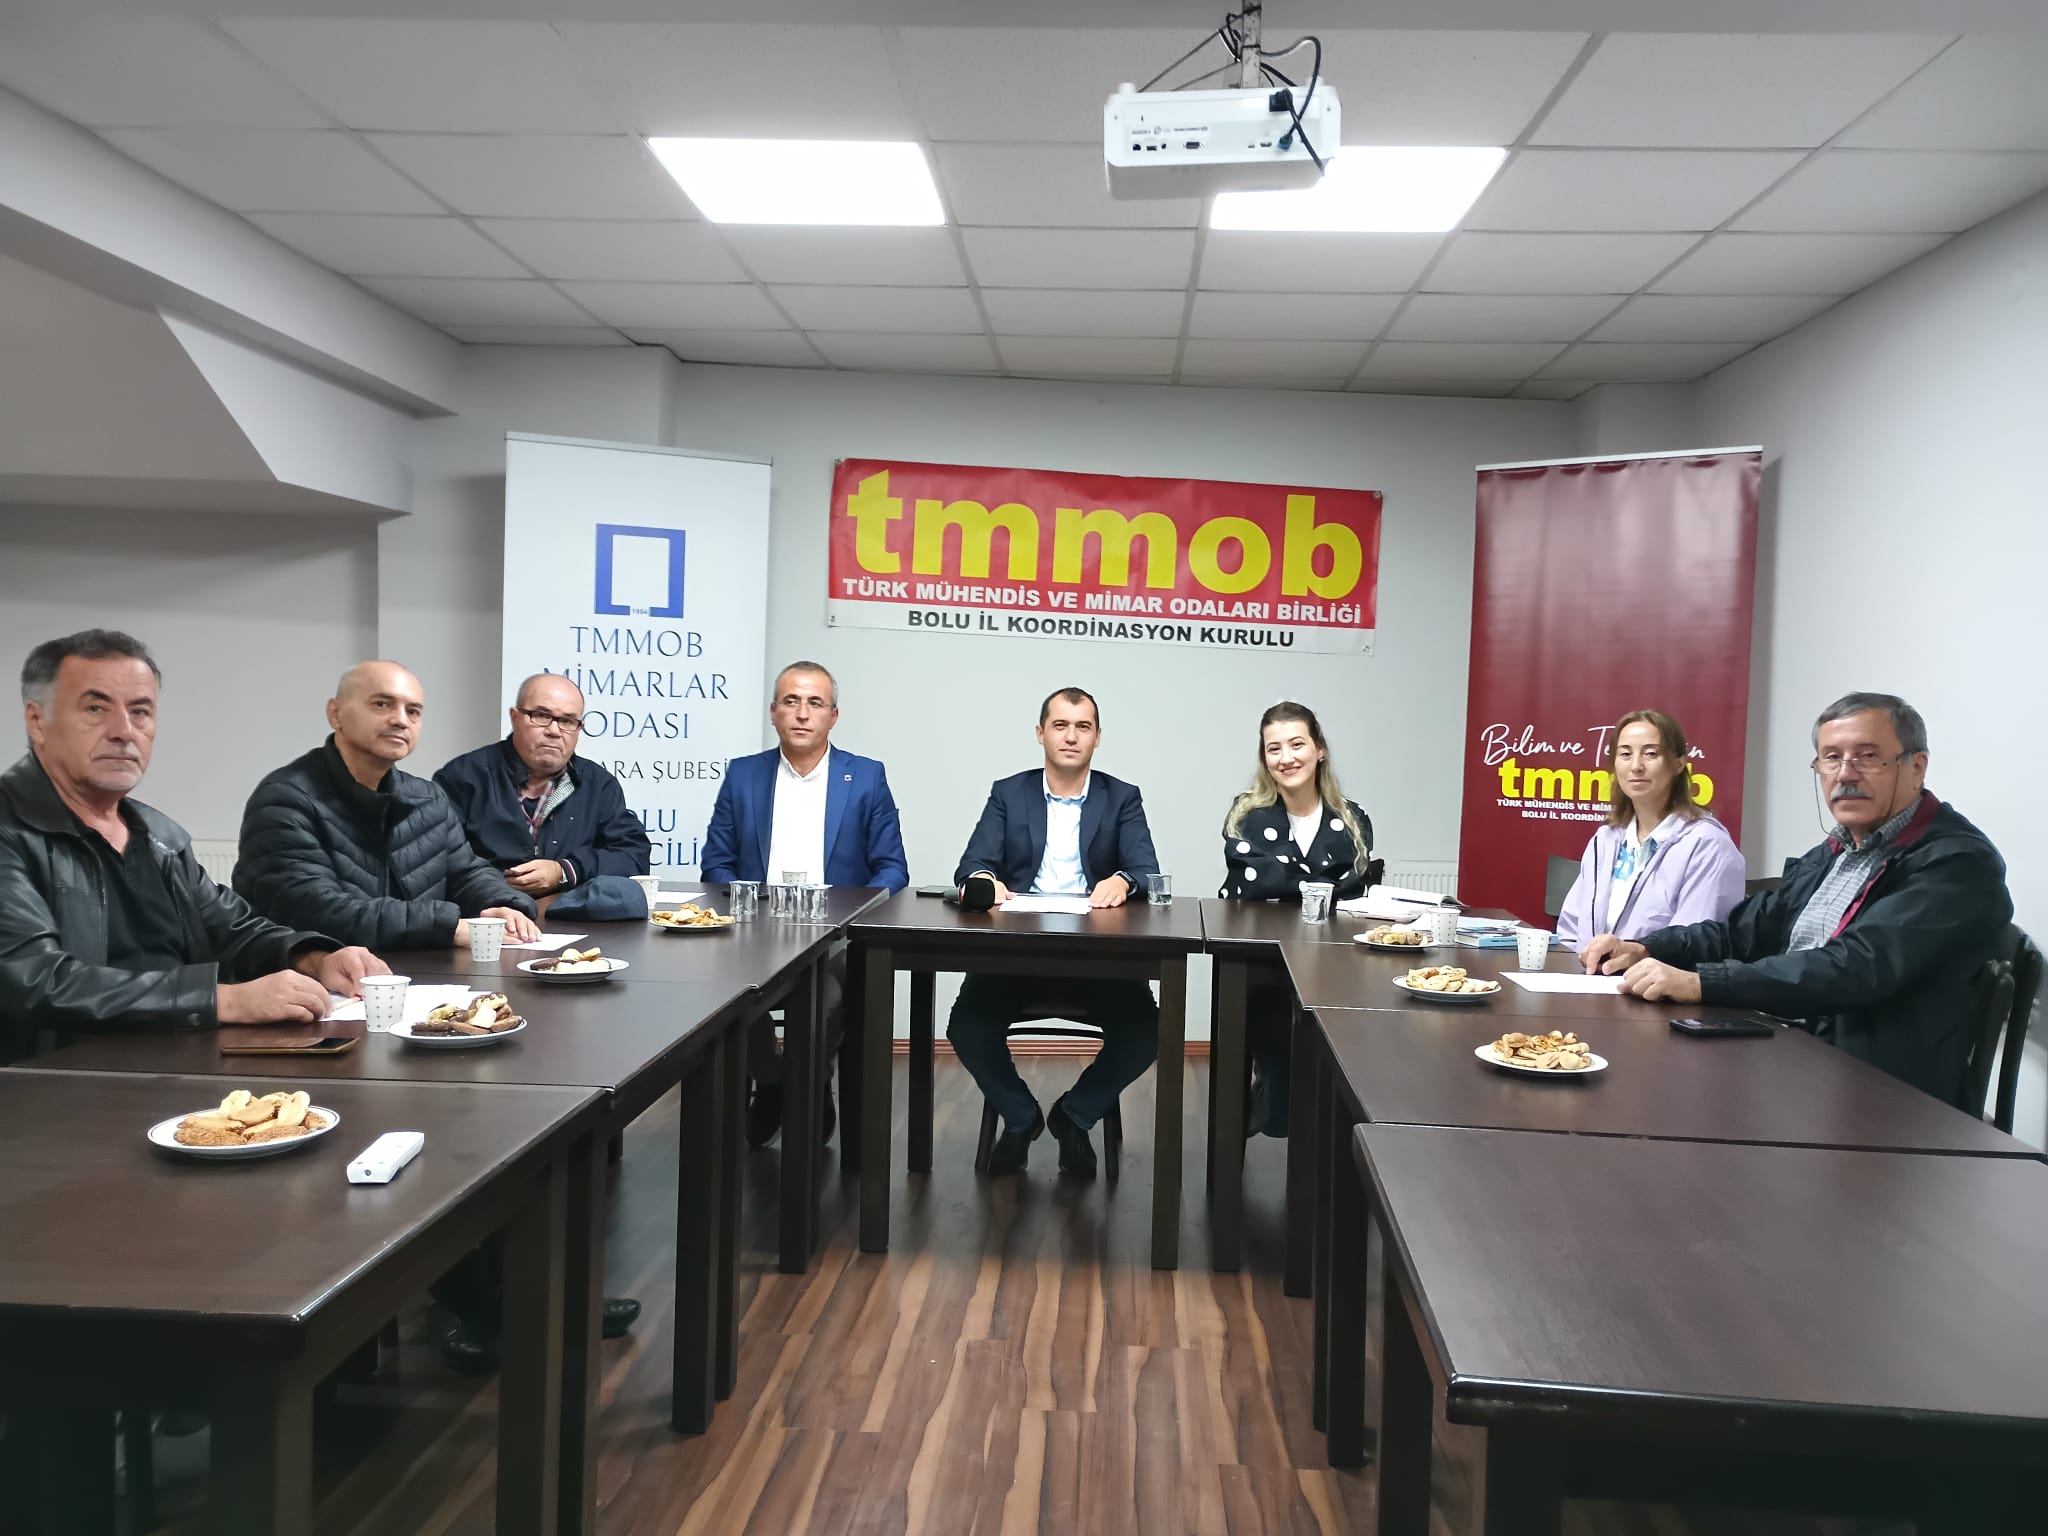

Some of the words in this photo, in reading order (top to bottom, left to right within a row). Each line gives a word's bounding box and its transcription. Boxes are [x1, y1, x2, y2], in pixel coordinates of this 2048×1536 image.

[847, 469, 1363, 600] tmmob
[842, 576, 909, 599] TÜRK
[915, 580, 1041, 607] MÜHENDİS
[1046, 590, 1078, 609] VE
[1085, 590, 1164, 614] MİMAR
[1169, 597, 1269, 619] ODALARI
[1277, 600, 1362, 624] BİRLİĞİ
[570, 626, 704, 658] TMMOB
[908, 609, 971, 629] BOLU
[978, 610, 1000, 631] İL
[1007, 615, 1192, 642] KOORDİNASYON
[1200, 627, 1294, 647] KURULU
[543, 662, 729, 700] İMARLAR
[582, 710, 689, 739] ODASI
[1481, 723, 1556, 766] Bilim
[1560, 741, 1585, 755] ve
[1496, 798, 1523, 808] TÜRK
[1524, 800, 1575, 810] MÜHENDİS
[1577, 802, 1591, 811] VE
[1522, 810, 1547, 819] BOLU
